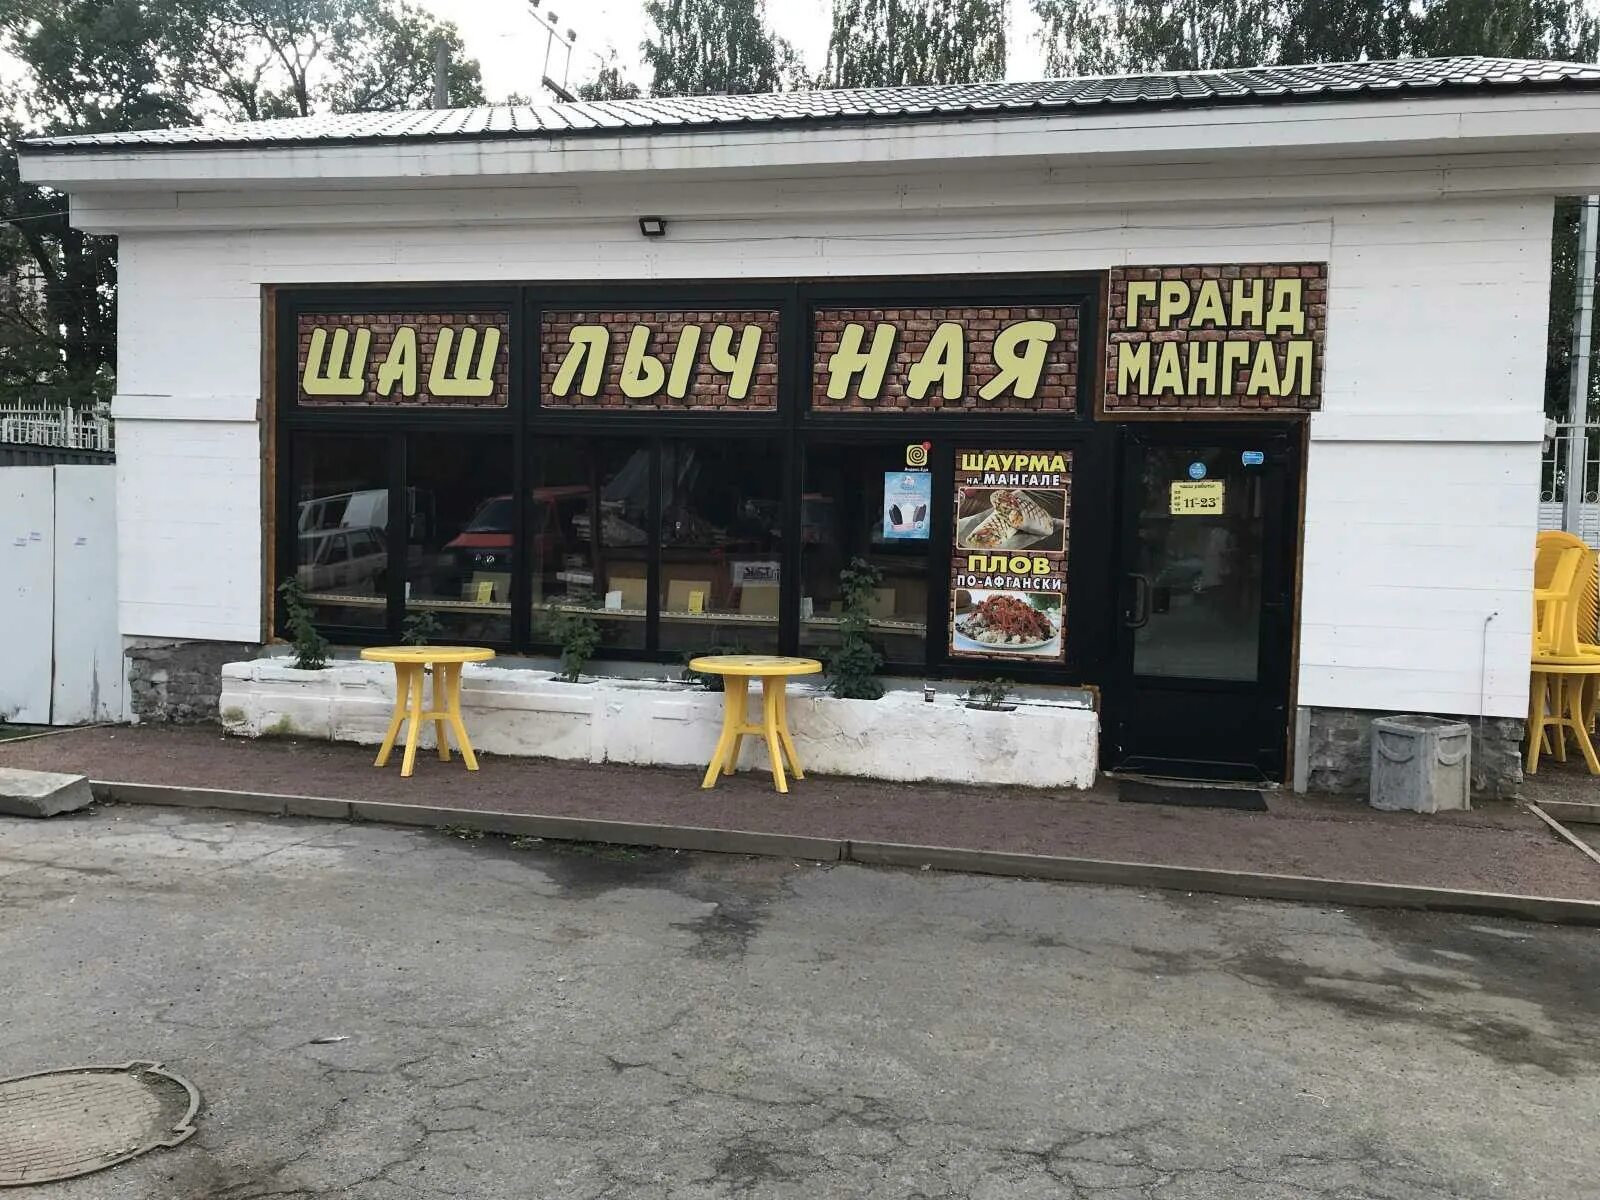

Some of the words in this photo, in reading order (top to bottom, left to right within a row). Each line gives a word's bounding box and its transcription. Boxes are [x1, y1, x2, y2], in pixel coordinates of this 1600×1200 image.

[1126, 278, 1305, 335] ГРАНД
[302, 326, 501, 397] ШАШ
[551, 324, 763, 400] ЛЫЧ
[826, 320, 1057, 401] НАЯ
[1117, 340, 1313, 397] МАНГАЛ
[961, 453, 1067, 473] ШАУРМА
[983, 473, 1060, 486] МАНГАЛЕ
[968, 555, 1051, 575] ПЛОВ
[957, 574, 1061, 590] ПО-АФГАНСКИ
